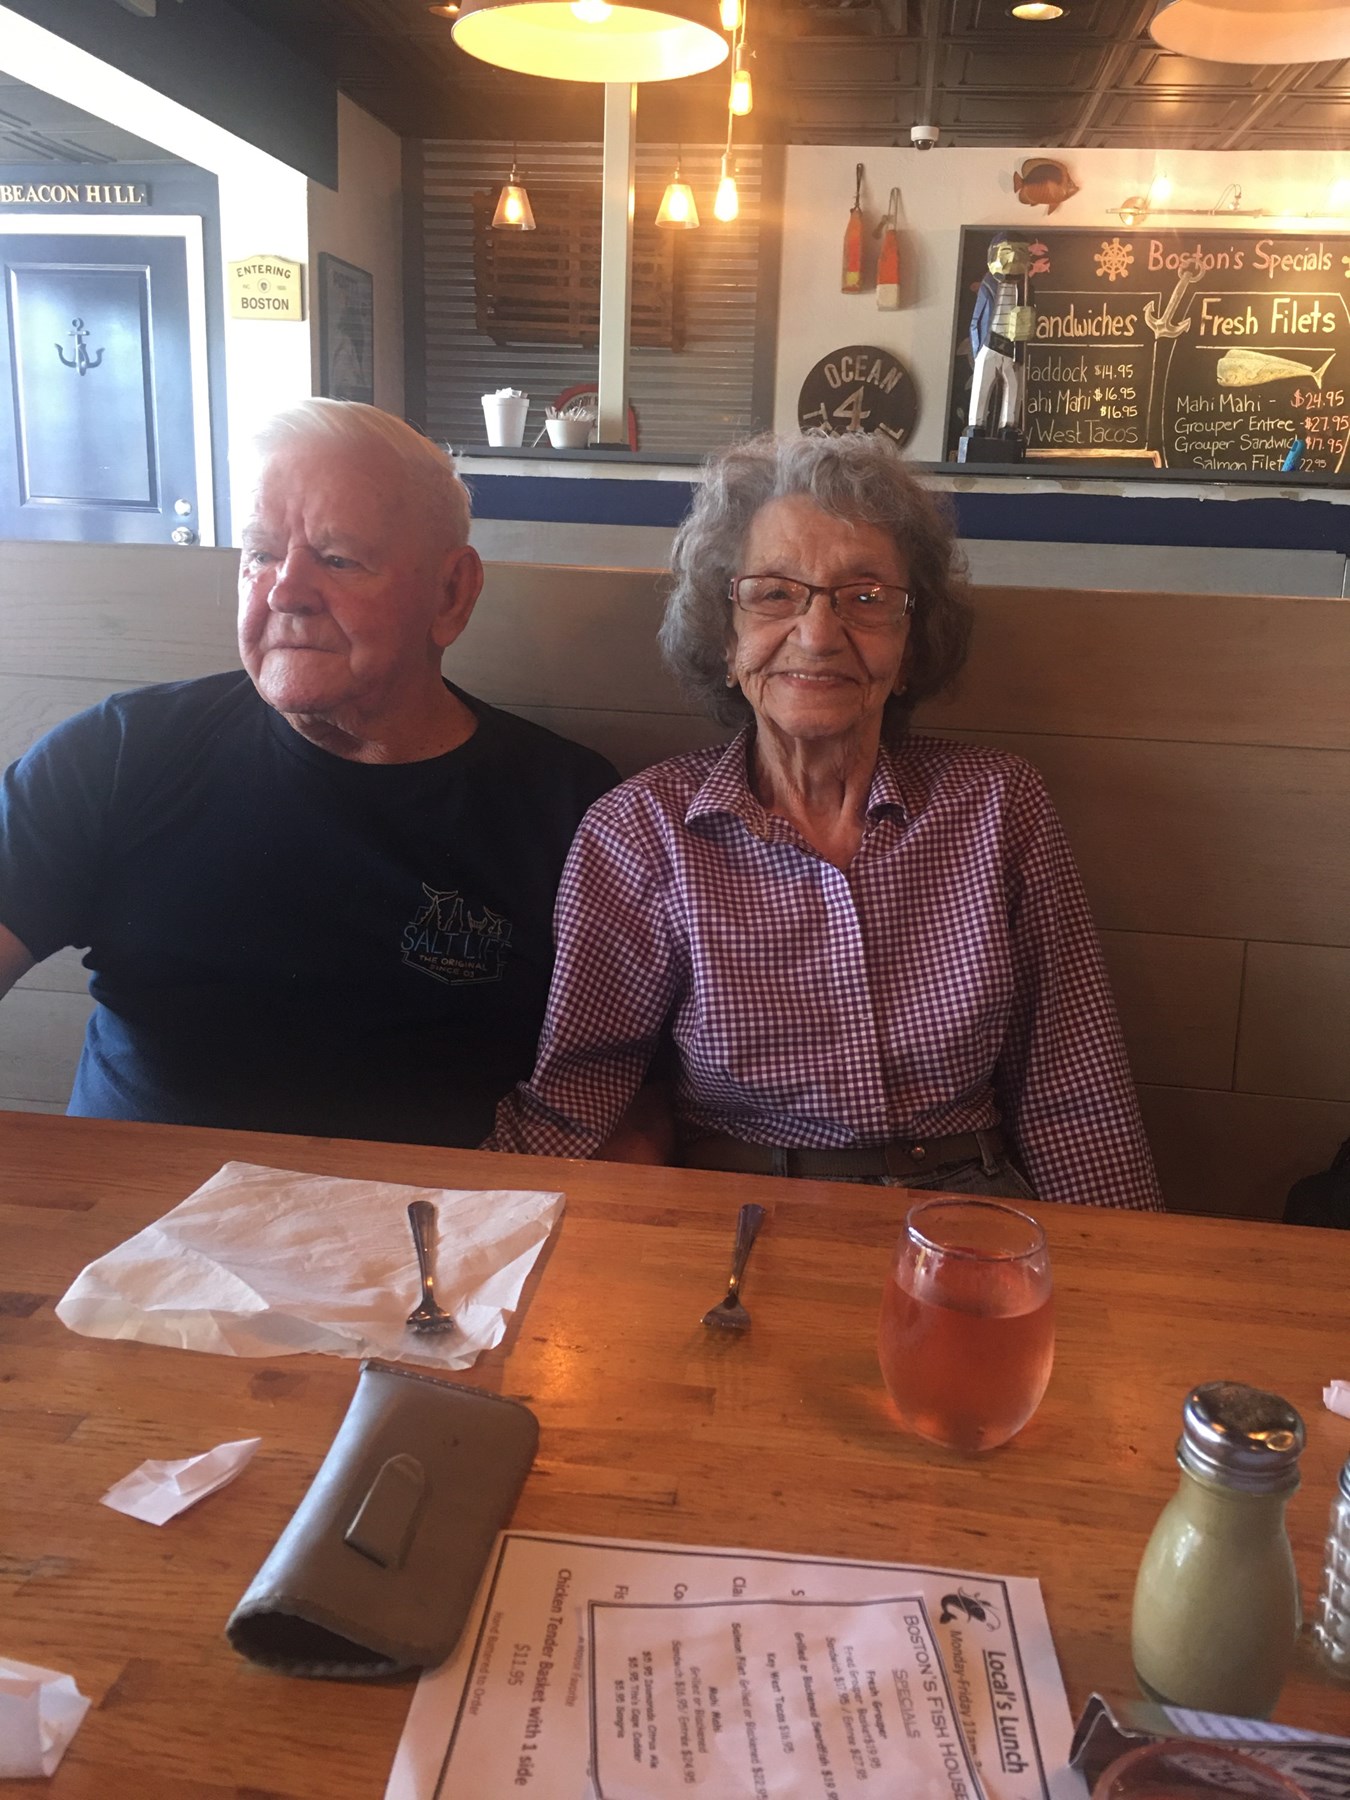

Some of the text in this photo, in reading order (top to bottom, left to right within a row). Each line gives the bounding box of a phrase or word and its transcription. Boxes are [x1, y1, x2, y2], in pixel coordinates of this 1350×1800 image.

[0, 184, 142, 204] BEACON HILL
[236, 264, 292, 279] ENTERING
[1148, 239, 1333, 279] Boston's Specials
[241, 297, 289, 311] BOSTON
[1200, 297, 1336, 336] Fresh Filets
[1036, 303, 1138, 339] andwiches
[824, 355, 903, 394] OCEAN
[1094, 364, 1134, 380] $14.95
[833, 385, 871, 431] 4
[1028, 386, 1137, 415] ahi Mahi $16.95
[1100, 405, 1138, 419] $16.95
[1176, 395, 1215, 414] Mahi
[1219, 394, 1261, 413] Mahi
[1290, 389, 1345, 411] $24.95
[1036, 418, 1085, 444] West
[1085, 419, 1139, 444] Tacos
[1174, 417, 1243, 437] Grouper
[1174, 436, 1235, 457] Grouper
[1305, 436, 1343, 454] $17.95
[1193, 456, 1247, 471] Salmon
[1252, 454, 1285, 472] Filet
[400, 924, 460, 956] SALT
[419, 954, 488, 972] THE ORIGINAL
[731, 1622, 743, 1654] Salmon
[794, 1632, 809, 1661] Grilled
[479, 1636, 501, 1674] Battered
[507, 1643, 531, 1686] $11.95
[736, 1656, 748, 1677] Filet
[765, 1652, 778, 1668] Key
[799, 1665, 809, 1673] or
[476, 1676, 487, 1685] to
[514, 1568, 572, 1786] Chicken Tender Basket with 1 side
[769, 1671, 782, 1692] West
[950, 1630, 975, 1717] Monday-Friday
[468, 1689, 485, 1715] Order
[565, 1673, 582, 1707] Favorite
[802, 1676, 819, 1718] Blackened
[866, 1670, 888, 1740] Fresh Grouper
[895, 1669, 920, 1738] SPECIALS
[614, 1706, 626, 1738] Sangria
[708, 1686, 723, 1733] Mahi Mahi
[774, 1697, 787, 1723] Tacos
[826, 1636, 843, 1674] Sandwich
[849, 1749, 867, 1781] $27.95
[987, 1650, 1029, 1774] Local's Lunch
[694, 1709, 708, 1753] Blackened
[744, 1721, 761, 1764] Blackened
[812, 1722, 829, 1766] Swordfish
[681, 1750, 696, 1783] $24.95
